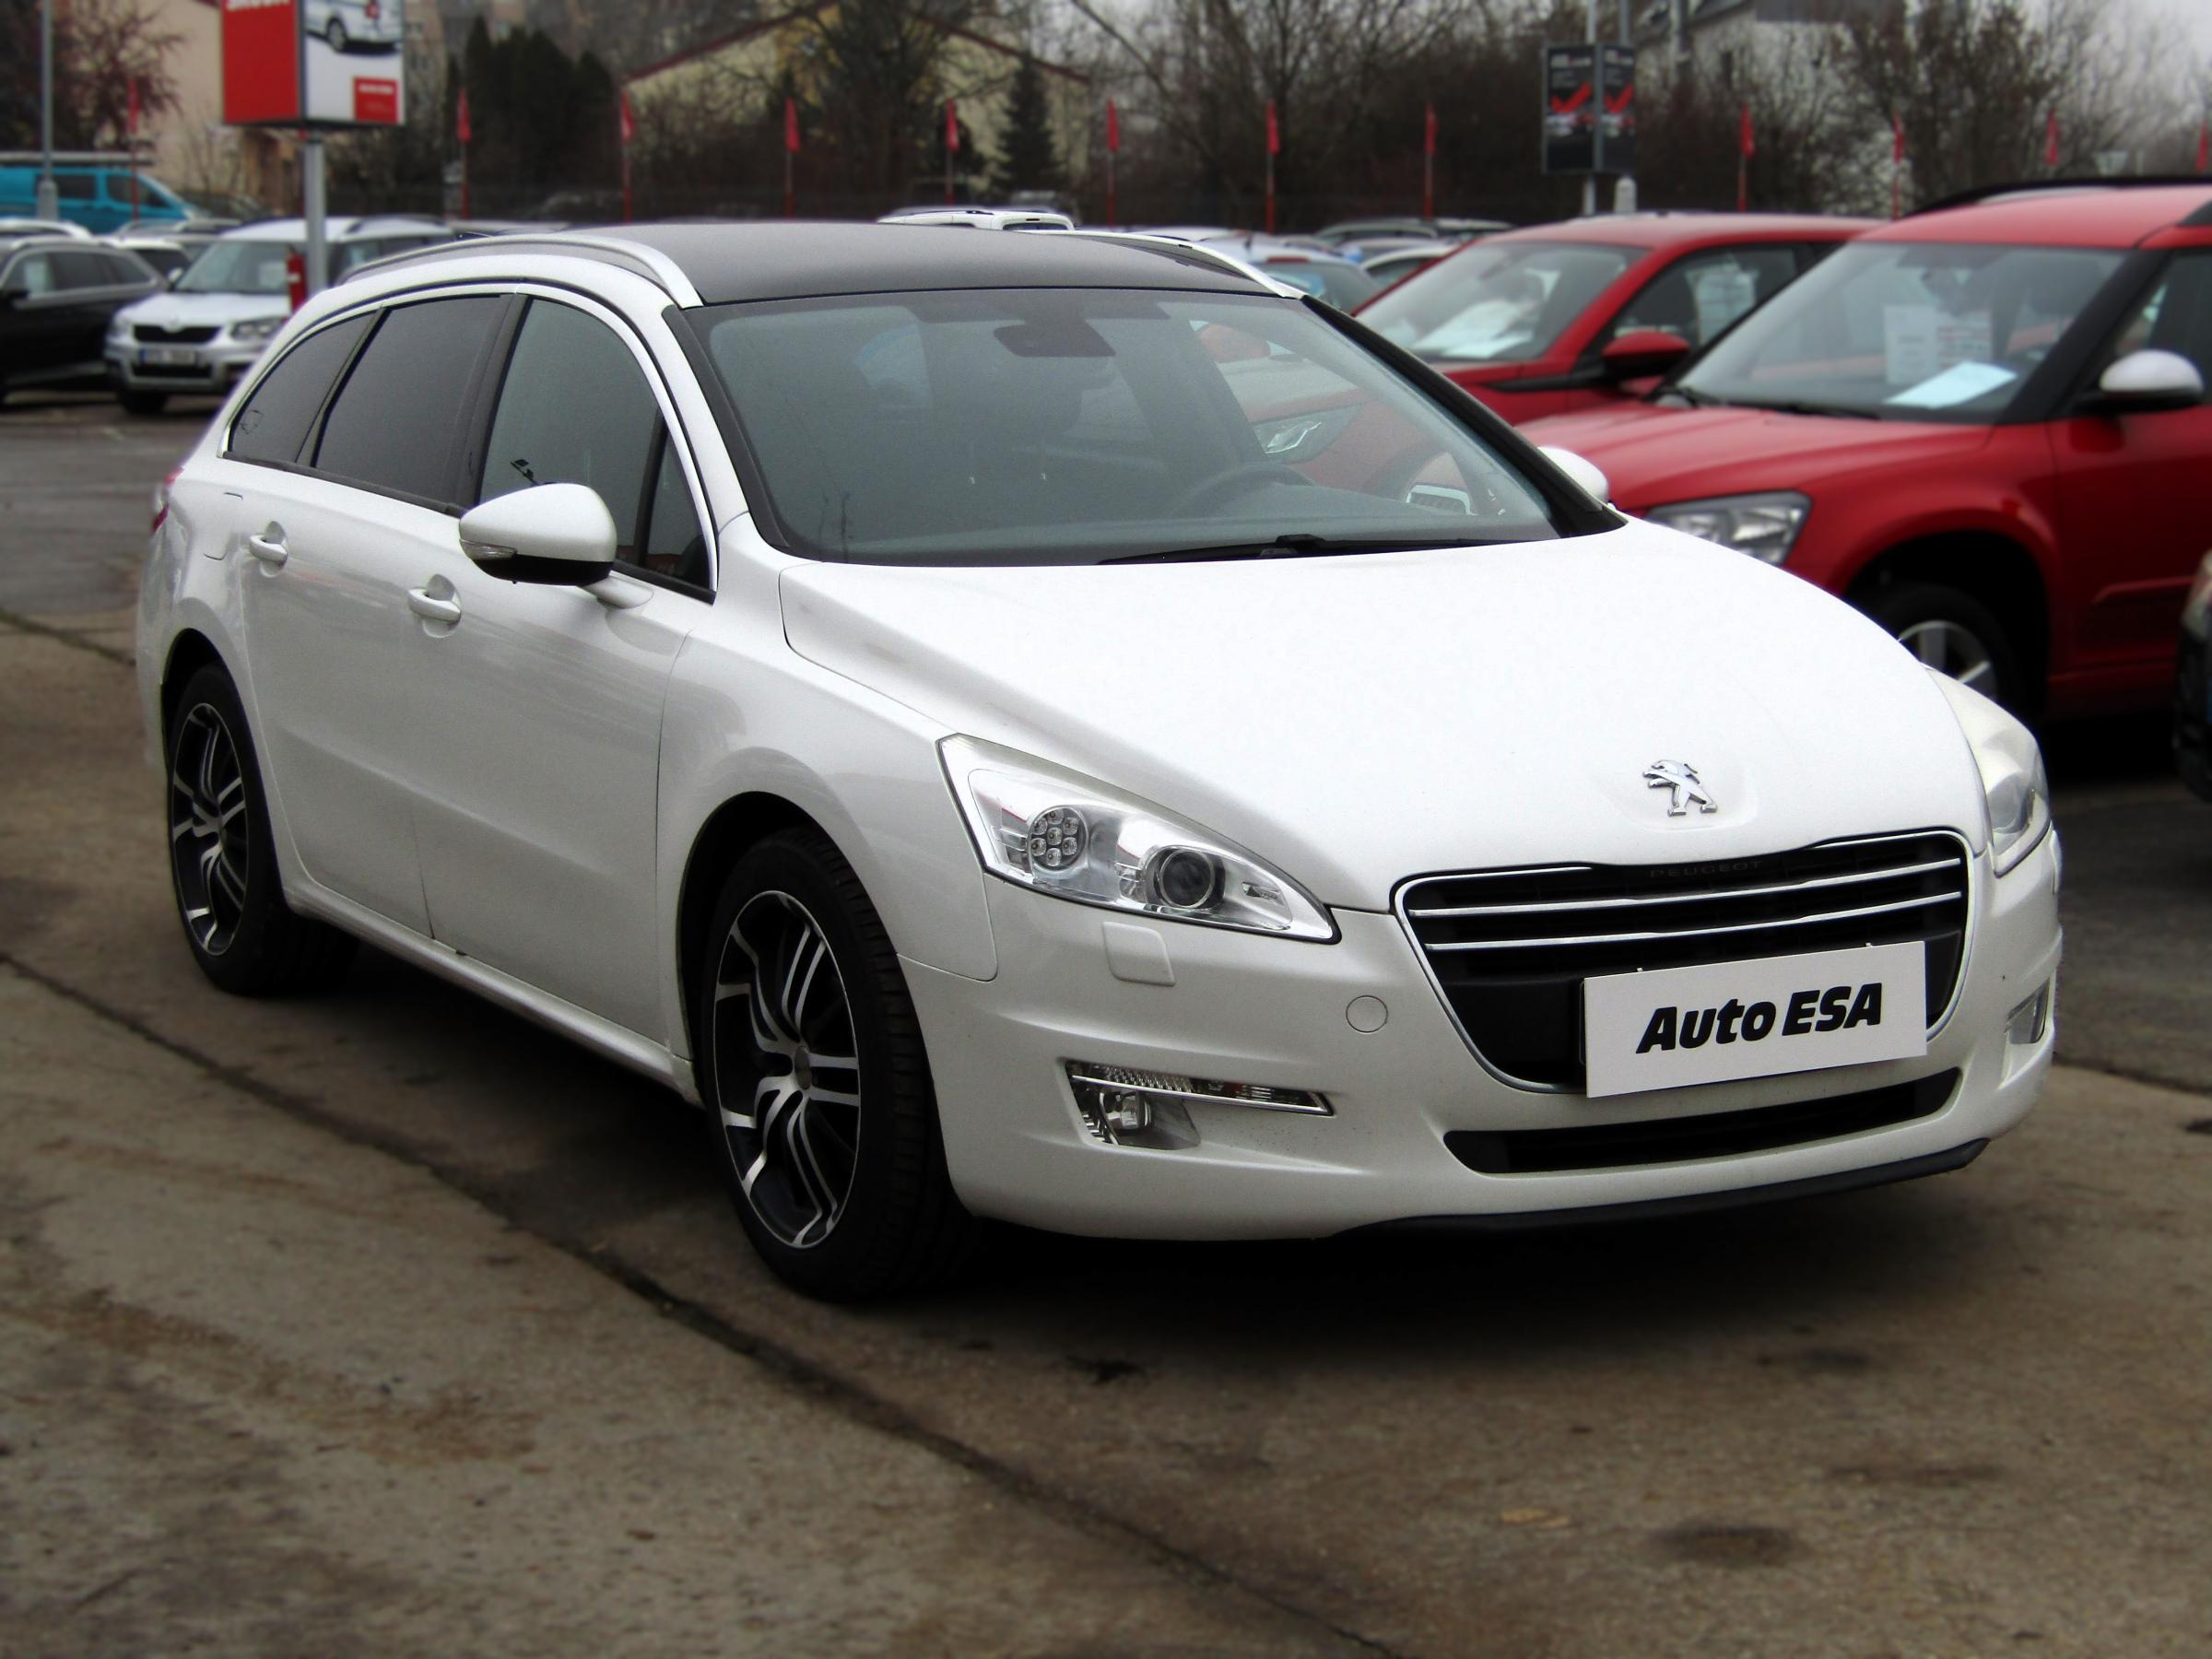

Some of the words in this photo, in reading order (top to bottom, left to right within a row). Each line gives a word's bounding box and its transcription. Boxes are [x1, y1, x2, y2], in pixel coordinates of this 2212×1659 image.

[1650, 860, 1763, 878] PEUGEOT
[1635, 998, 1777, 1054] Auto
[1782, 982, 1883, 1037] ESA
